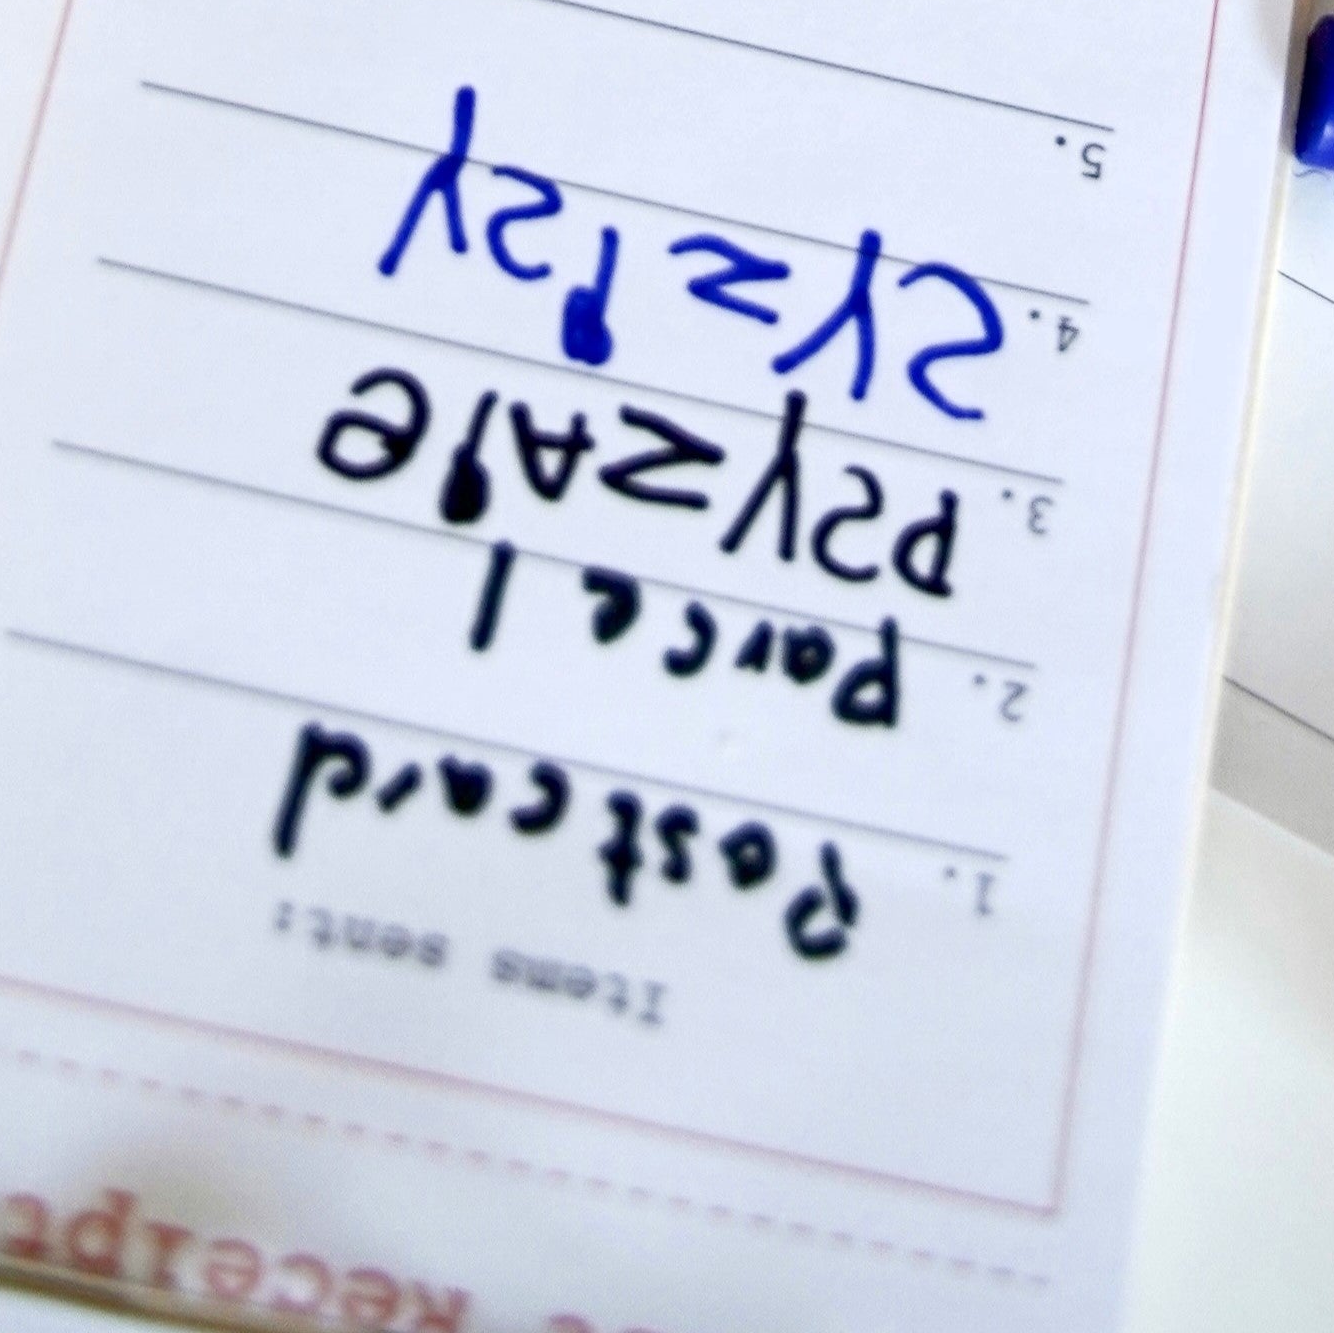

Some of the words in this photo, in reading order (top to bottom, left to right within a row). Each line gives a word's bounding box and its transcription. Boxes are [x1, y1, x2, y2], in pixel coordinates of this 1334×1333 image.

[1055, 136, 1107, 180] 5.
[1029, 307, 1081, 353] 4.
[1001, 487, 1054, 535] 3.
[467, 540, 901, 729] Parcel
[973, 672, 1030, 723] 2.
[944, 864, 999, 918] 1.
[275, 900, 450, 969] sent:
[490, 949, 668, 1027] Items
